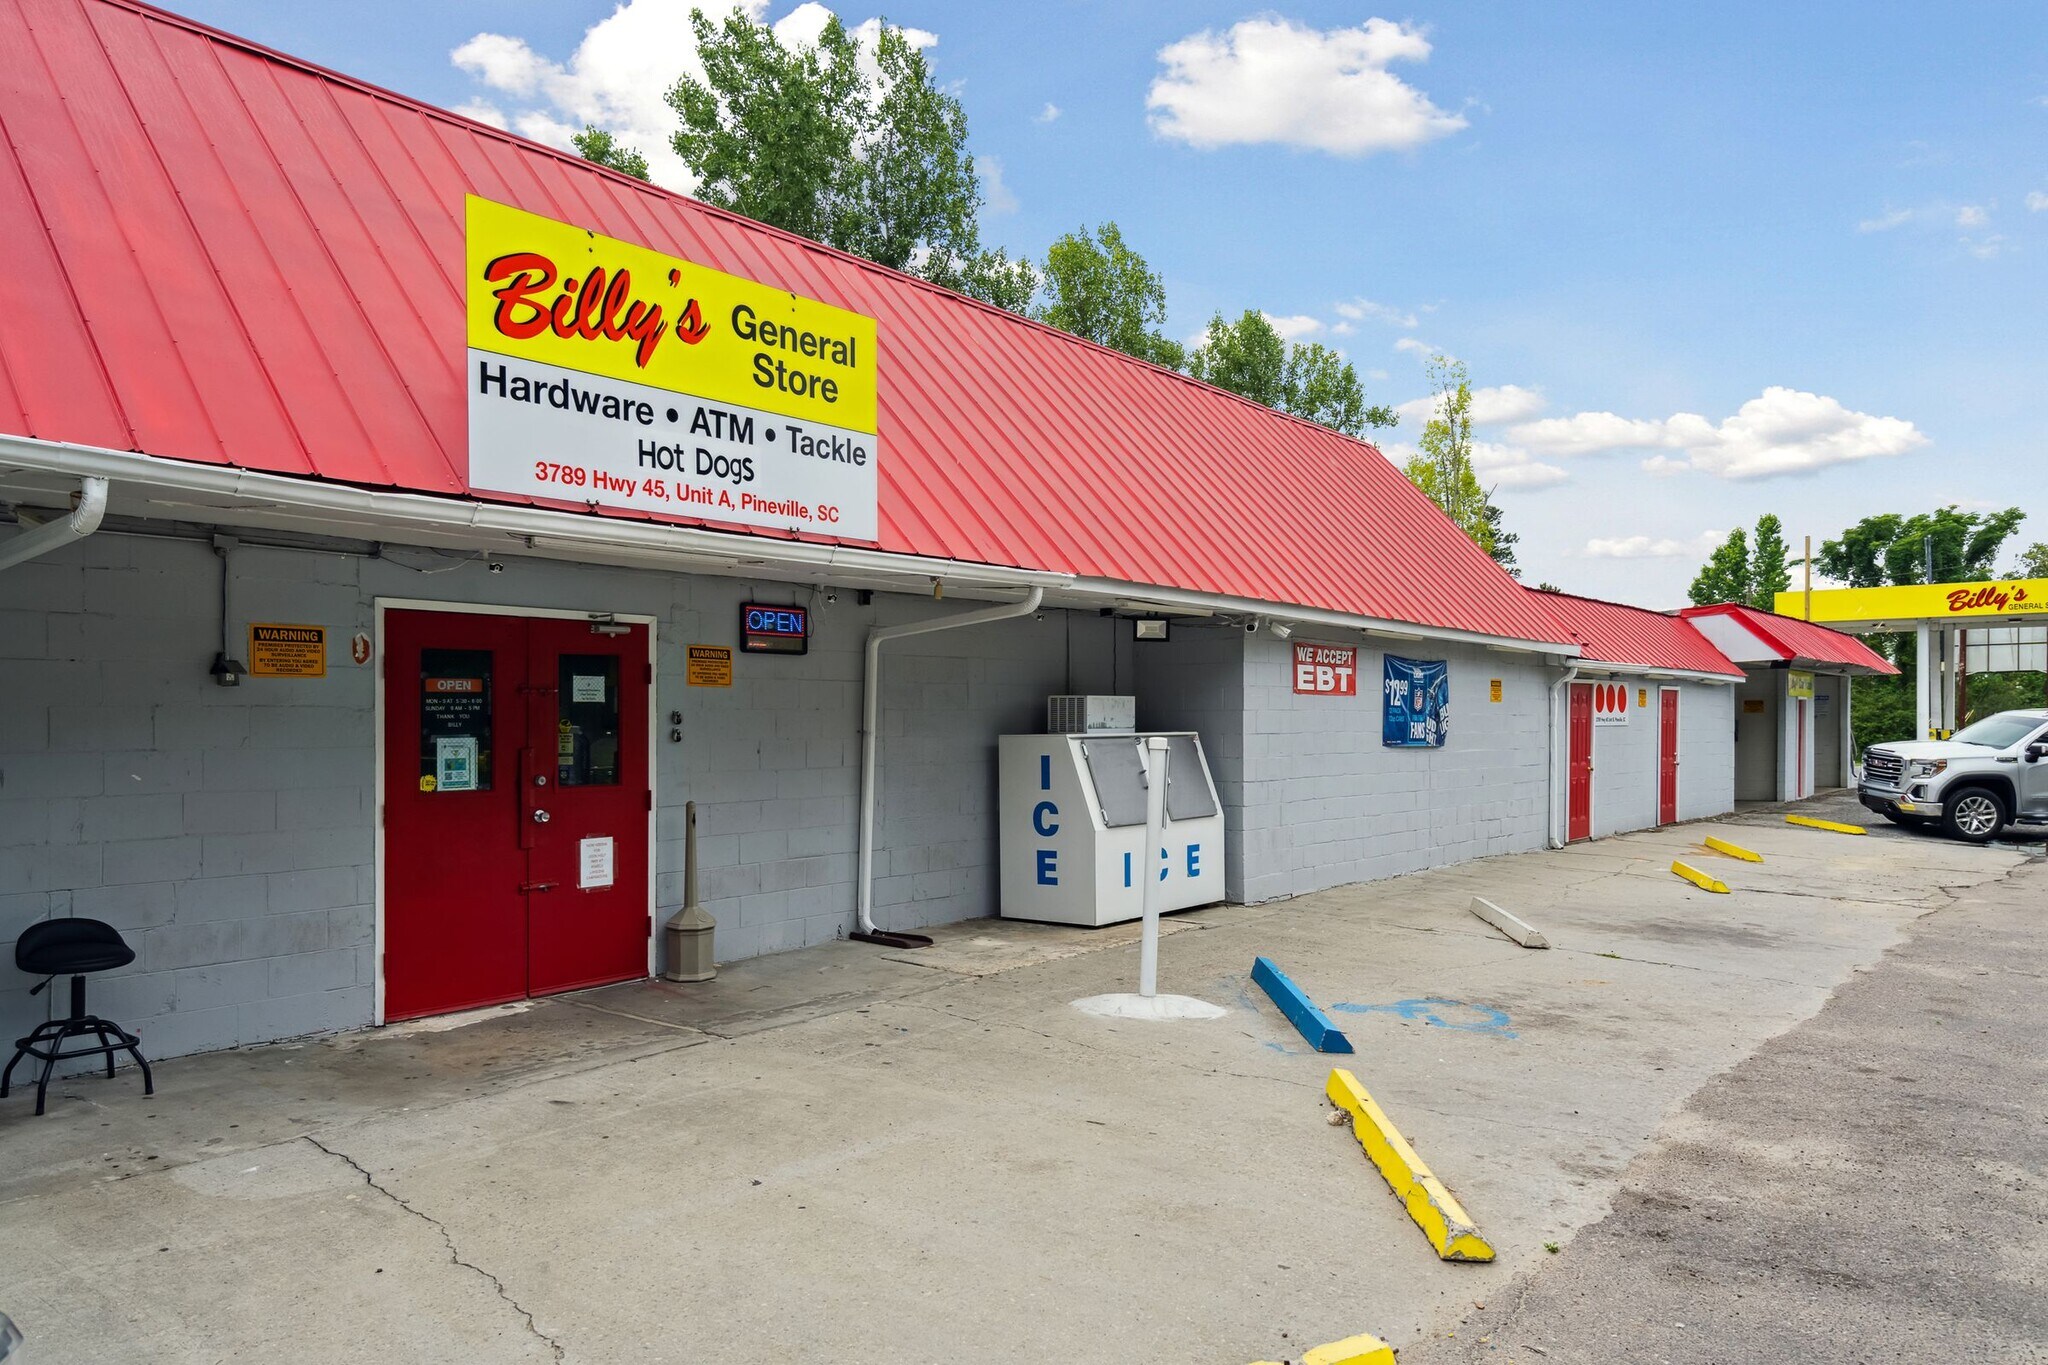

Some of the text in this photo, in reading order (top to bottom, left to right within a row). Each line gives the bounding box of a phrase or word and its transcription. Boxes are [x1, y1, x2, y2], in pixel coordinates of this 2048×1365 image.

[484, 252, 711, 370] Billy's
[732, 304, 856, 369] General
[752, 352, 839, 404] Store
[480, 361, 867, 467] Hardware ATM Tackle
[638, 439, 754, 485] Hot Dogs
[535, 461, 840, 523] 3789 Hwy 45, Unit A, Pineville, SC
[1946, 585, 2028, 611] Billy's
[2008, 602, 2043, 611] GENERAL
[258, 628, 319, 641] WARNING
[748, 610, 802, 633] OPEN
[691, 649, 728, 659] WARNING
[1297, 646, 1353, 665] WE ACCEPT
[437, 680, 472, 690] OPEN
[1297, 664, 1353, 692] EBT
[1410, 721, 1426, 739] FANS
[1032, 754, 1060, 886] ICE
